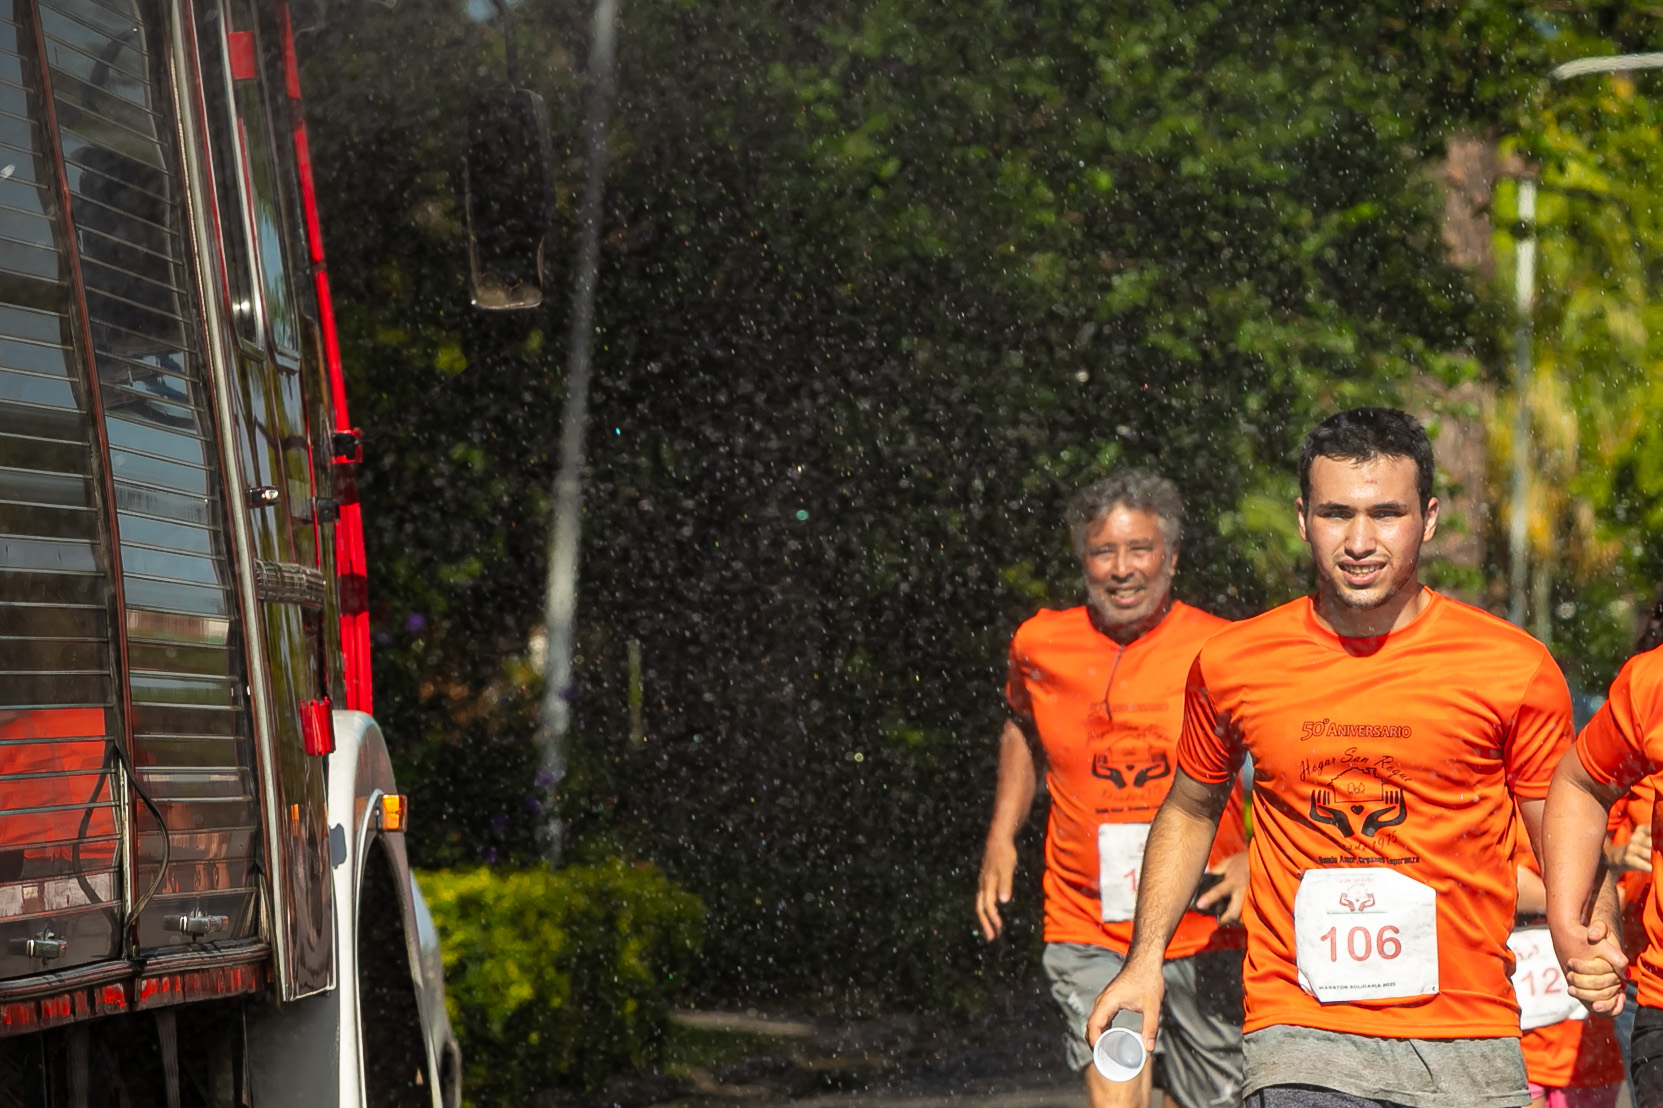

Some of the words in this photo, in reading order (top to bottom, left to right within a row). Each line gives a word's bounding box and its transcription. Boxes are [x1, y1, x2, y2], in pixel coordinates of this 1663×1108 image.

[1326, 723, 1412, 738] ANIVERSARIO
[1300, 757, 1336, 782] Hogar
[1340, 747, 1370, 764] San
[1373, 755, 1413, 782] Roque
[1320, 924, 1403, 964] 106
